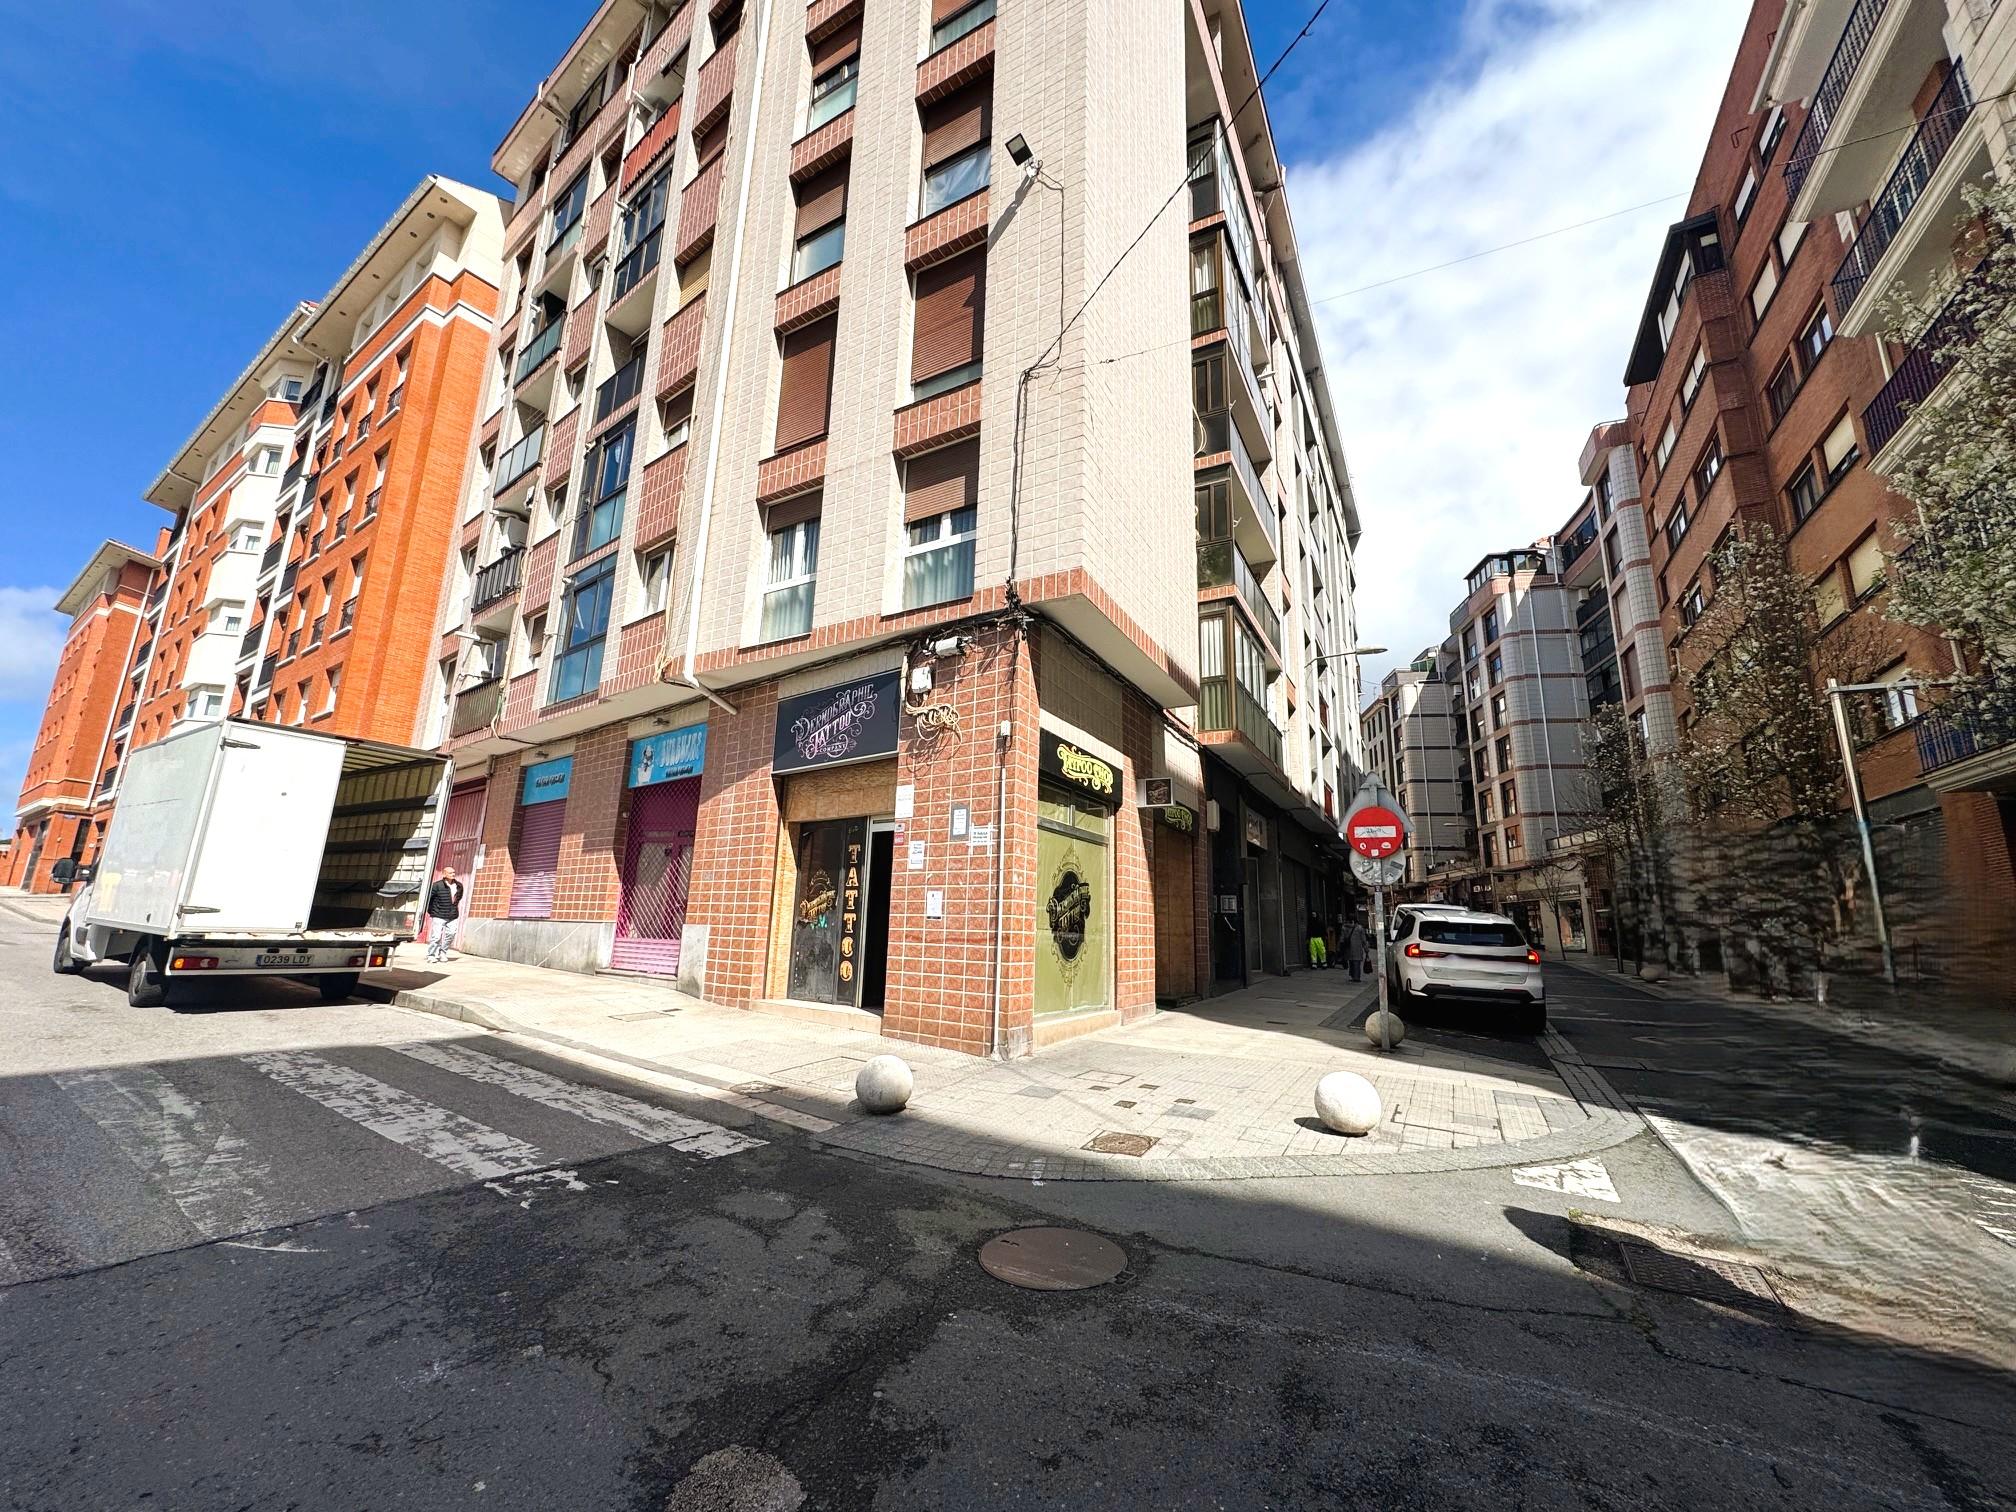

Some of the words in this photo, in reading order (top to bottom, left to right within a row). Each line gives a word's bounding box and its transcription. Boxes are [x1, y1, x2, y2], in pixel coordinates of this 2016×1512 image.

[806, 711, 852, 758] TATTOO
[818, 743, 847, 754] COMPANY
[1057, 745, 1093, 777] TATTOO
[840, 844, 861, 982] TATTOO
[263, 955, 290, 964] 0239
[292, 955, 313, 964] LDY
